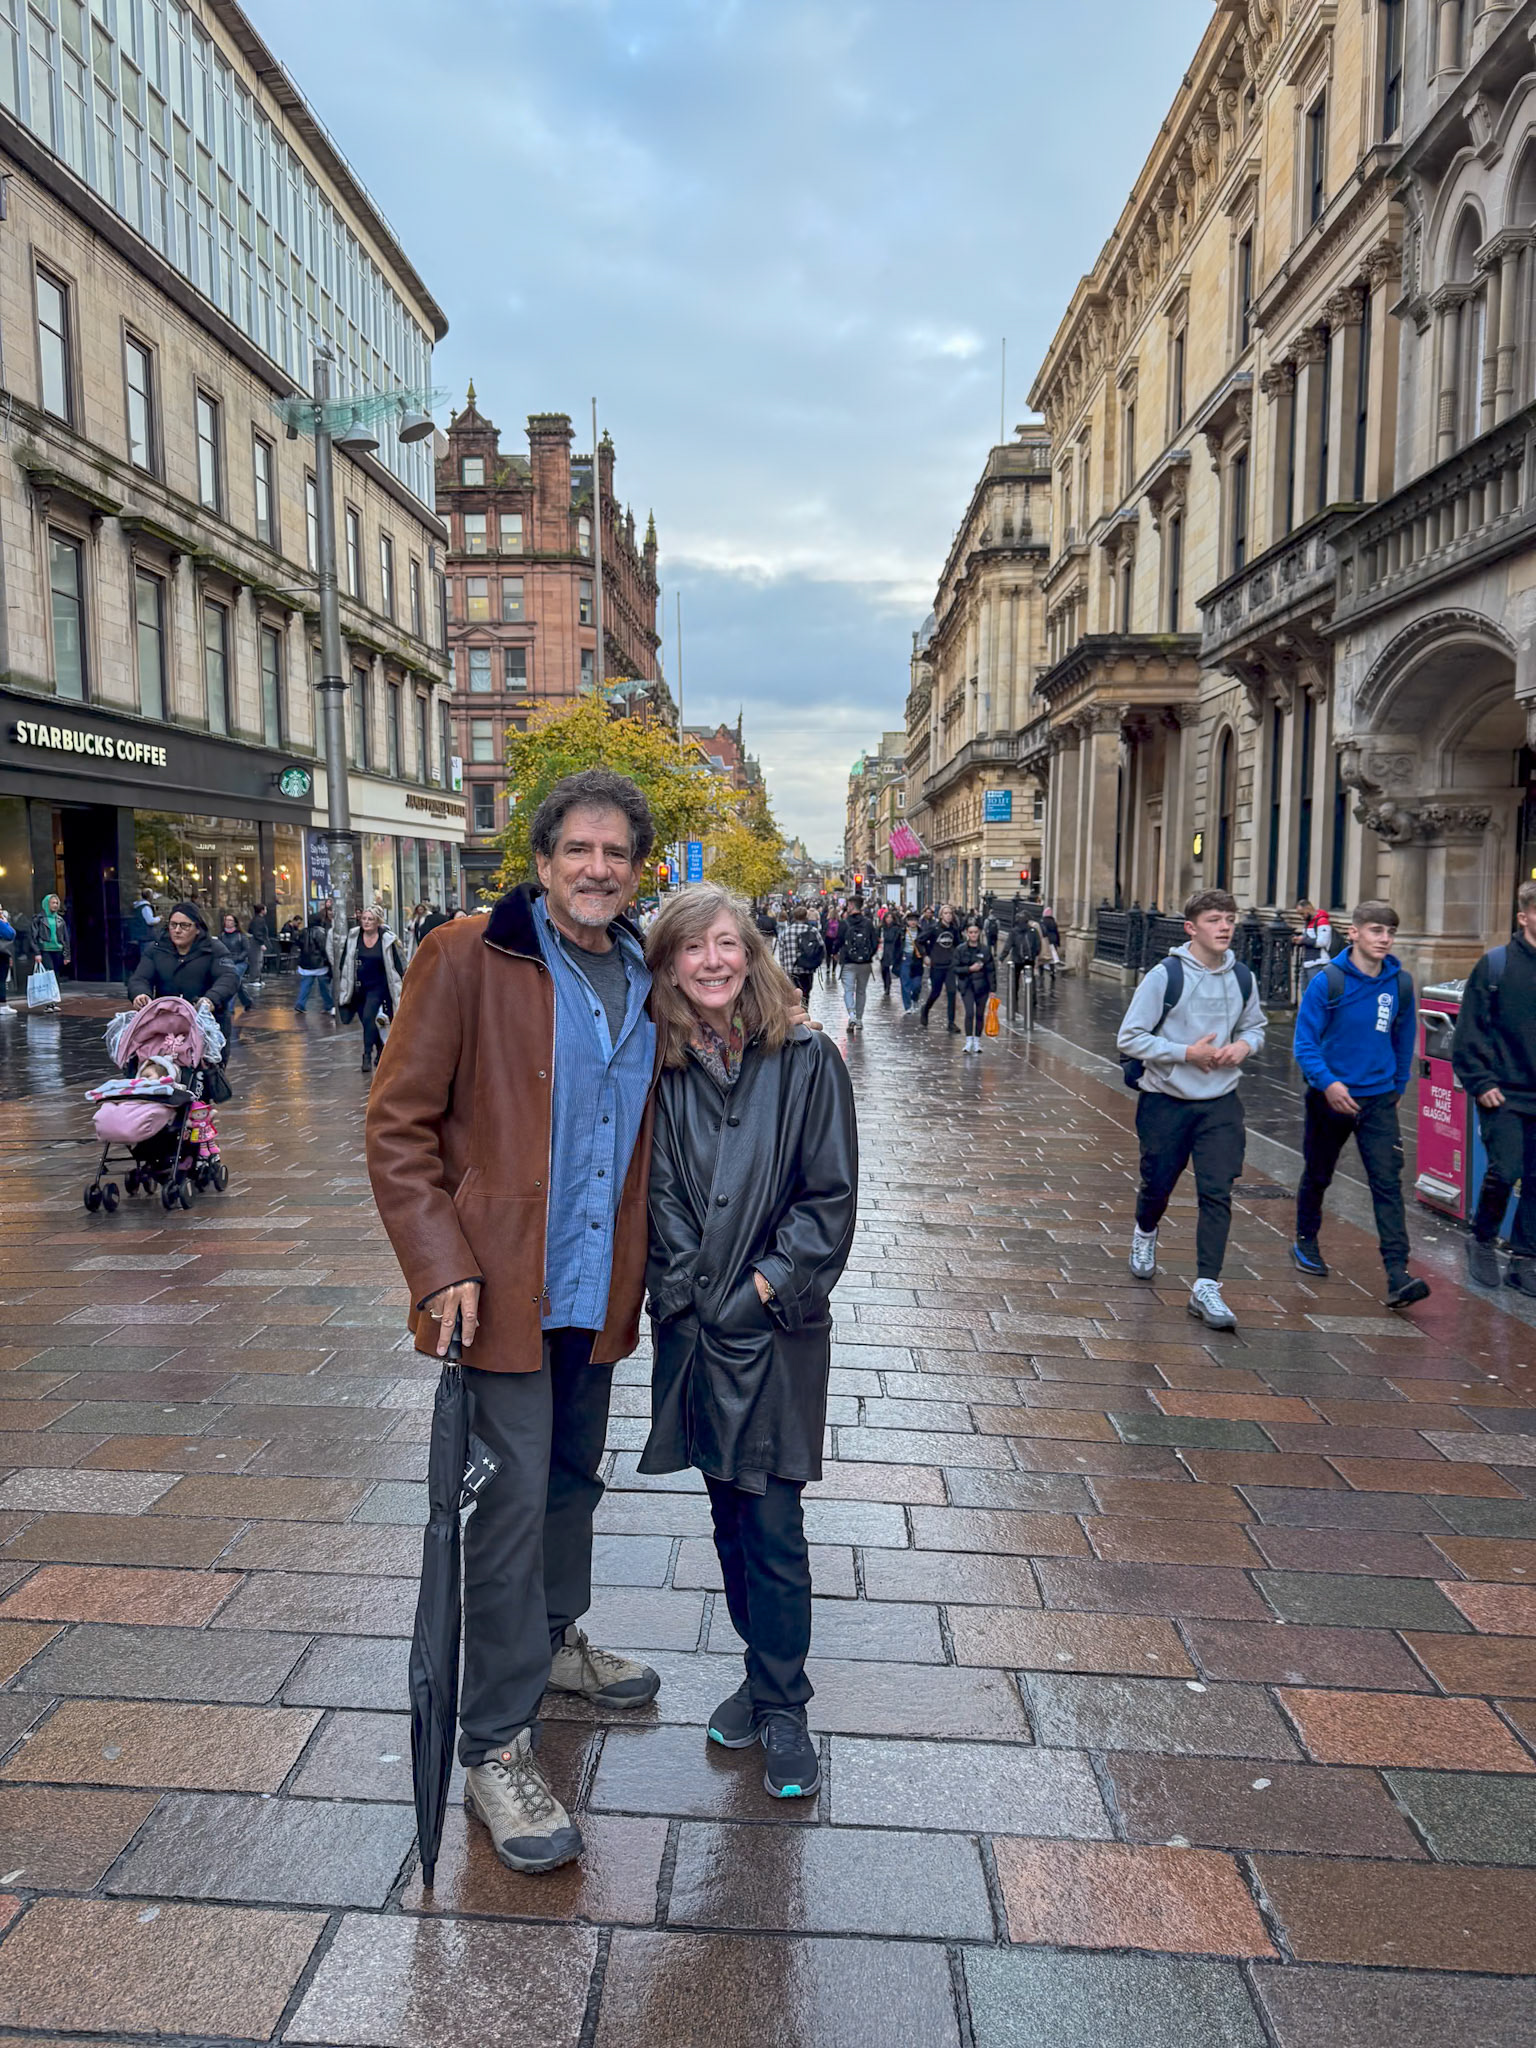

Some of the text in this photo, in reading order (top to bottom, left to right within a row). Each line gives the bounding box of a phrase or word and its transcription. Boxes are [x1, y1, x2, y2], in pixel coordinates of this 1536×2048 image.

[16, 719, 167, 767] STARBUCKS COFFEE
[1431, 1085, 1452, 1102] PEOPLE
[1422, 1105, 1452, 1124] GLASGOW
[1435, 1098, 1452, 1113] MAKE
